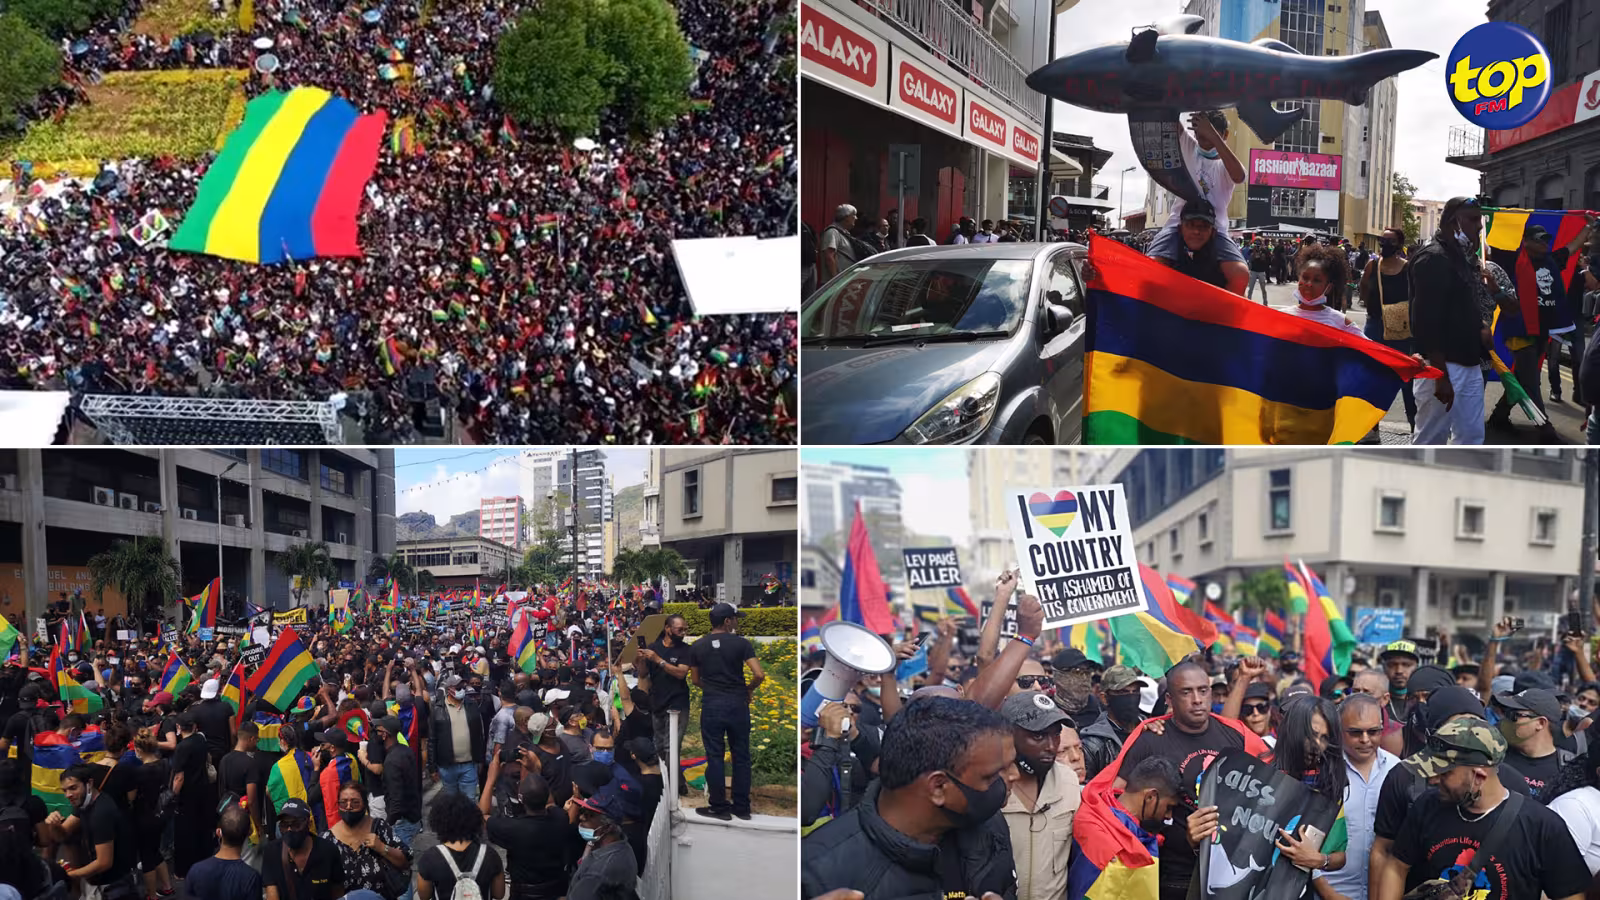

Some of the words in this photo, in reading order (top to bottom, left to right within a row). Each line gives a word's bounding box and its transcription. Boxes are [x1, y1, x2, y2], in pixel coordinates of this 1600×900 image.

[801, 19, 872, 75] ALAXY
[903, 72, 954, 115] GALAXY
[972, 109, 1005, 139] GALAXY
[1014, 132, 1038, 156] GALAXY
[1017, 495, 1033, 538] I
[1077, 490, 1116, 532] MY
[905, 554, 926, 567] LEV
[1029, 535, 1123, 577] COUNTRY
[911, 568, 960, 586] ALLER
[1063, 575, 1115, 598] ASHAMED
[1118, 571, 1130, 588] OF
[1042, 601, 1064, 618] ITS
[248, 654, 260, 662] OUT
[1459, 836, 1473, 845] Life
